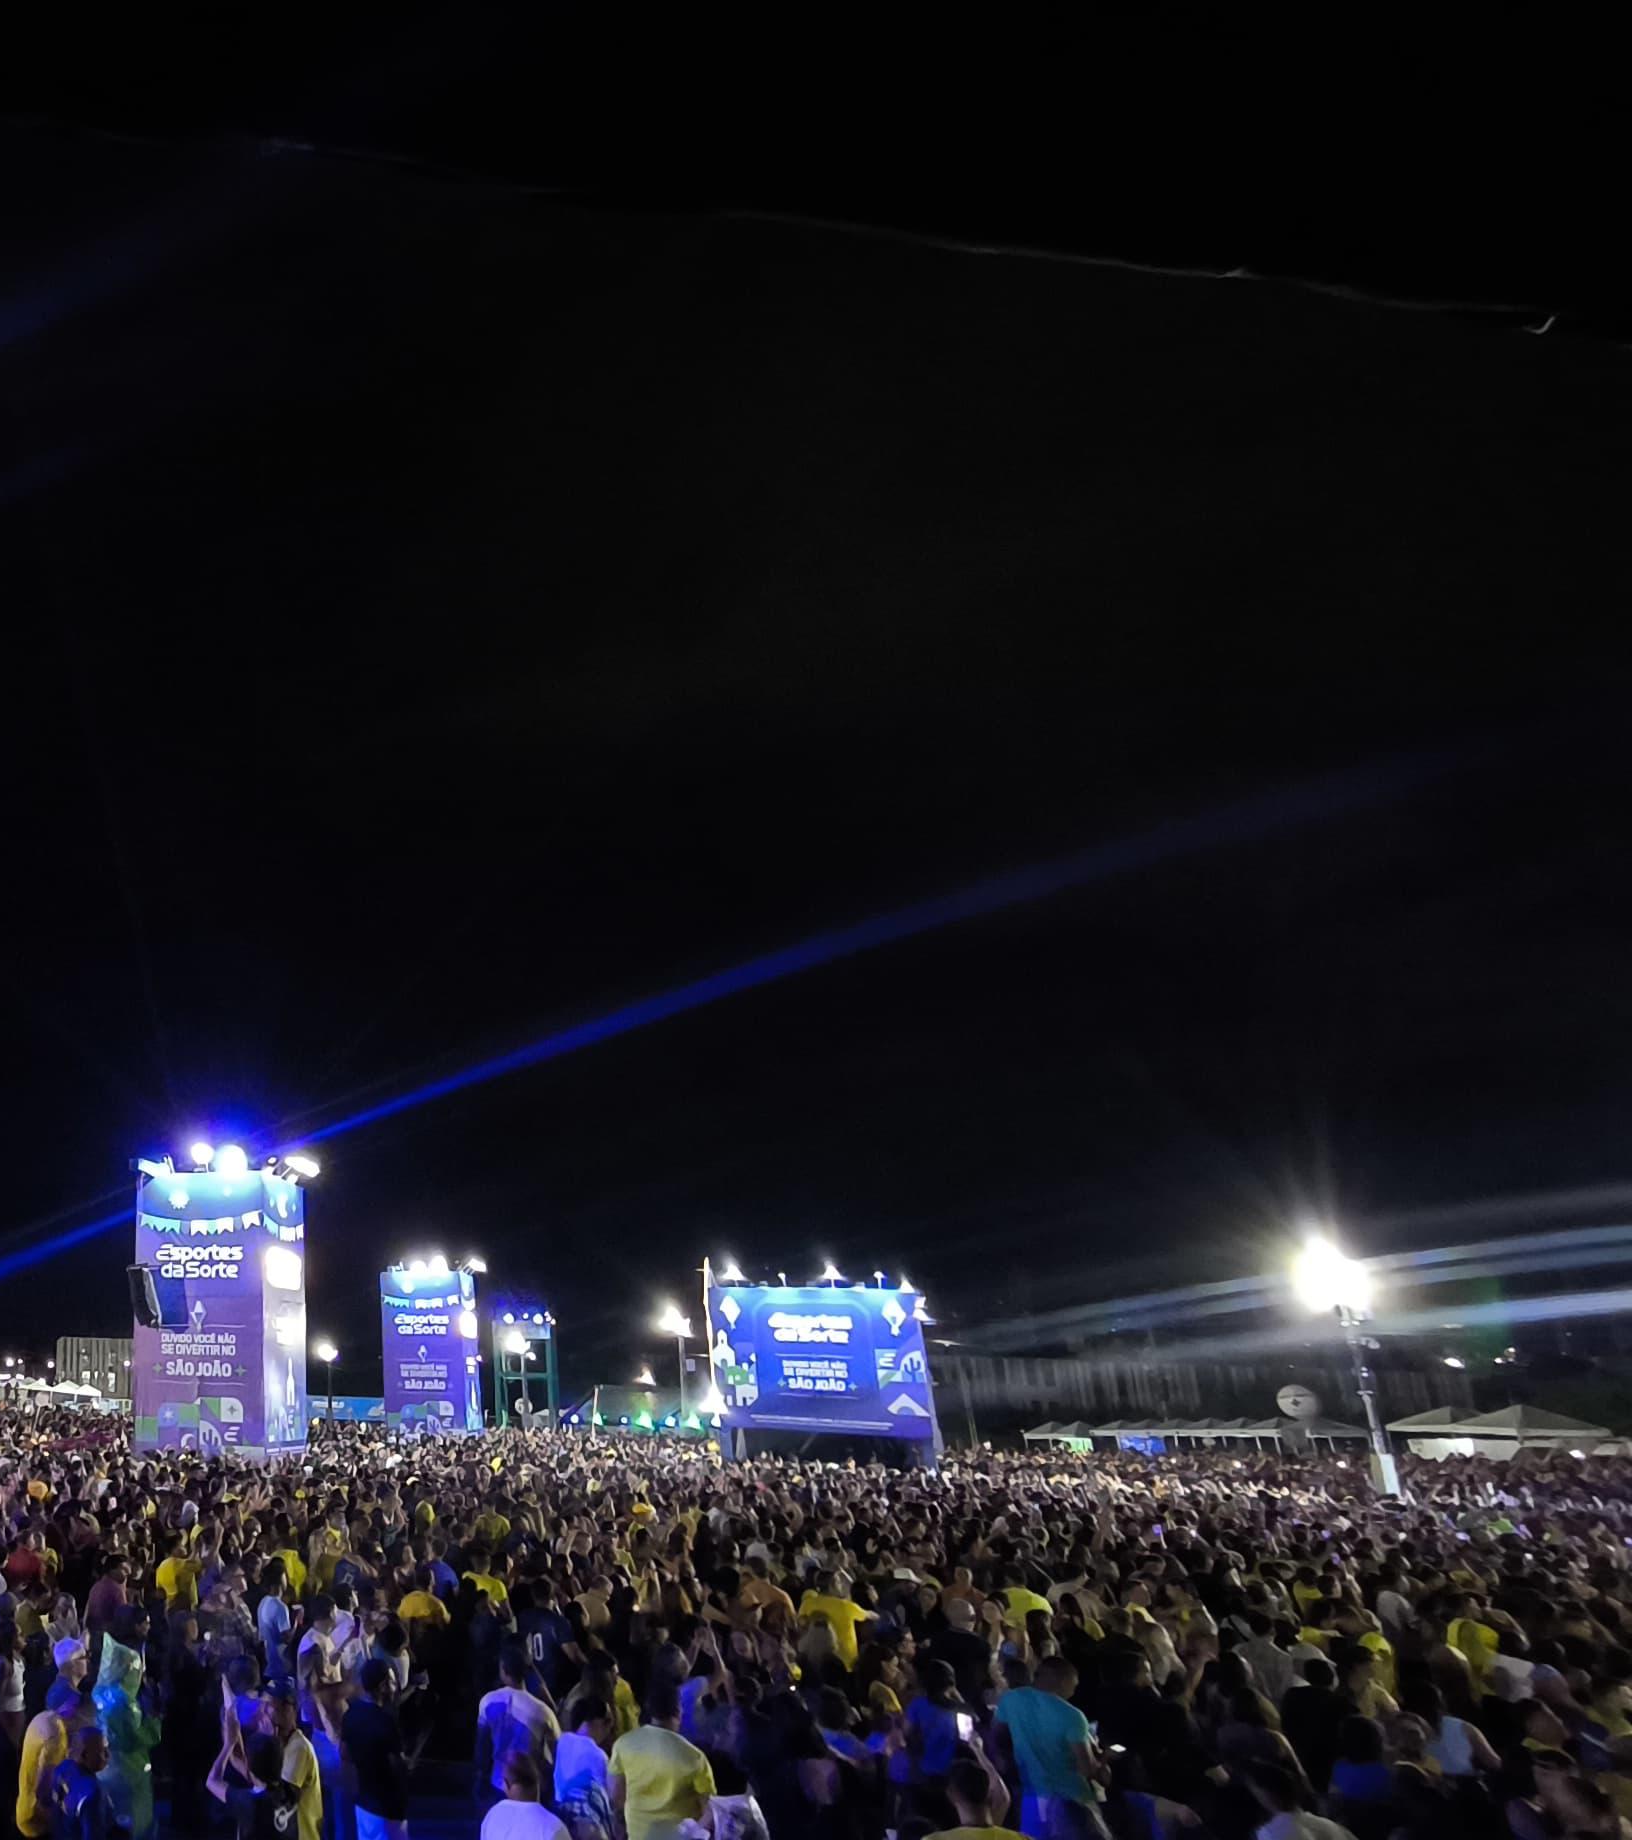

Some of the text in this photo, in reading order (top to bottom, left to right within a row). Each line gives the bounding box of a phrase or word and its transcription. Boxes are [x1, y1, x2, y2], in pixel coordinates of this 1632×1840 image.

[156, 1244, 244, 1264] Esportes
[161, 1343, 236, 1356] SE DIVERTIR NO
[166, 1359, 232, 1377] SÃO JOÃO
